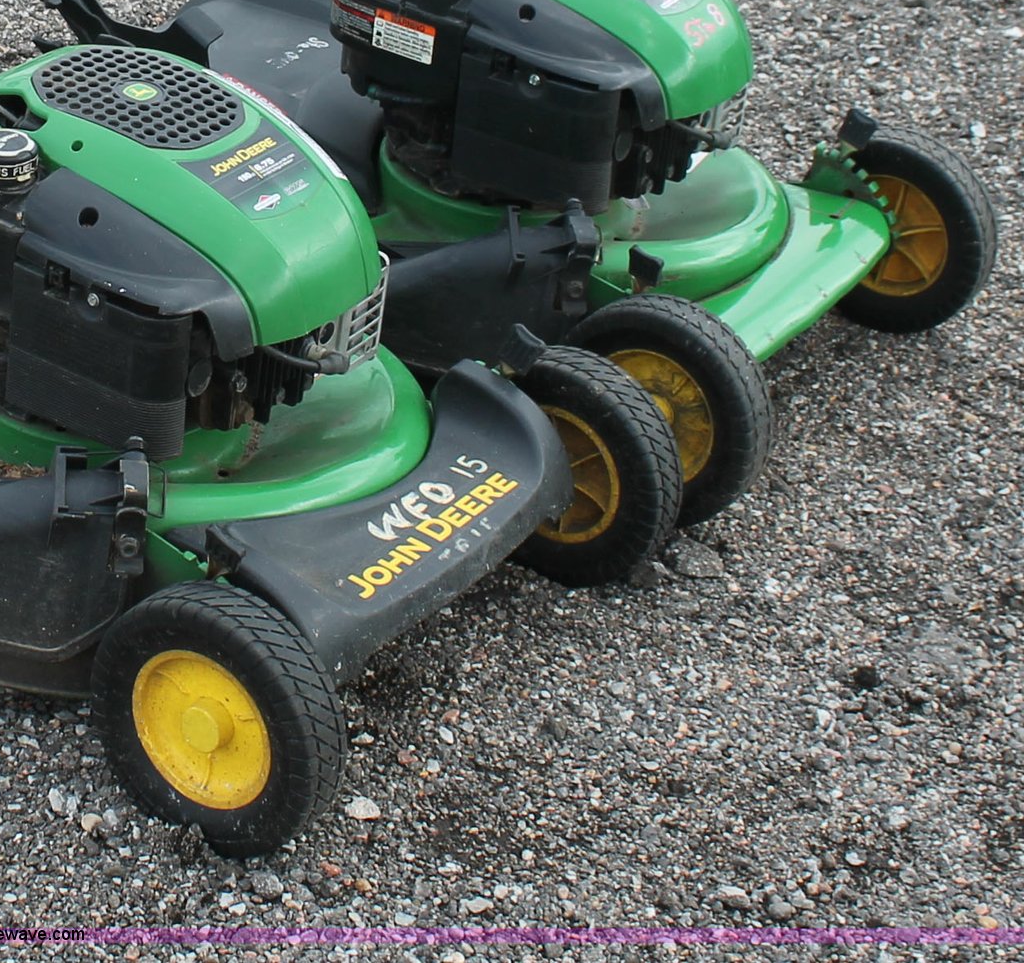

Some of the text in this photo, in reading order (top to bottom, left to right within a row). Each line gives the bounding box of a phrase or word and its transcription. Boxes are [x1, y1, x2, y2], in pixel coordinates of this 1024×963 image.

[13, 162, 35, 177] FUEL
[210, 155, 242, 176] JOHN
[236, 137, 277, 163] DEERE
[449, 455, 488, 478] 15
[347, 537, 432, 599] JOHN
[415, 472, 519, 542] DEERE
